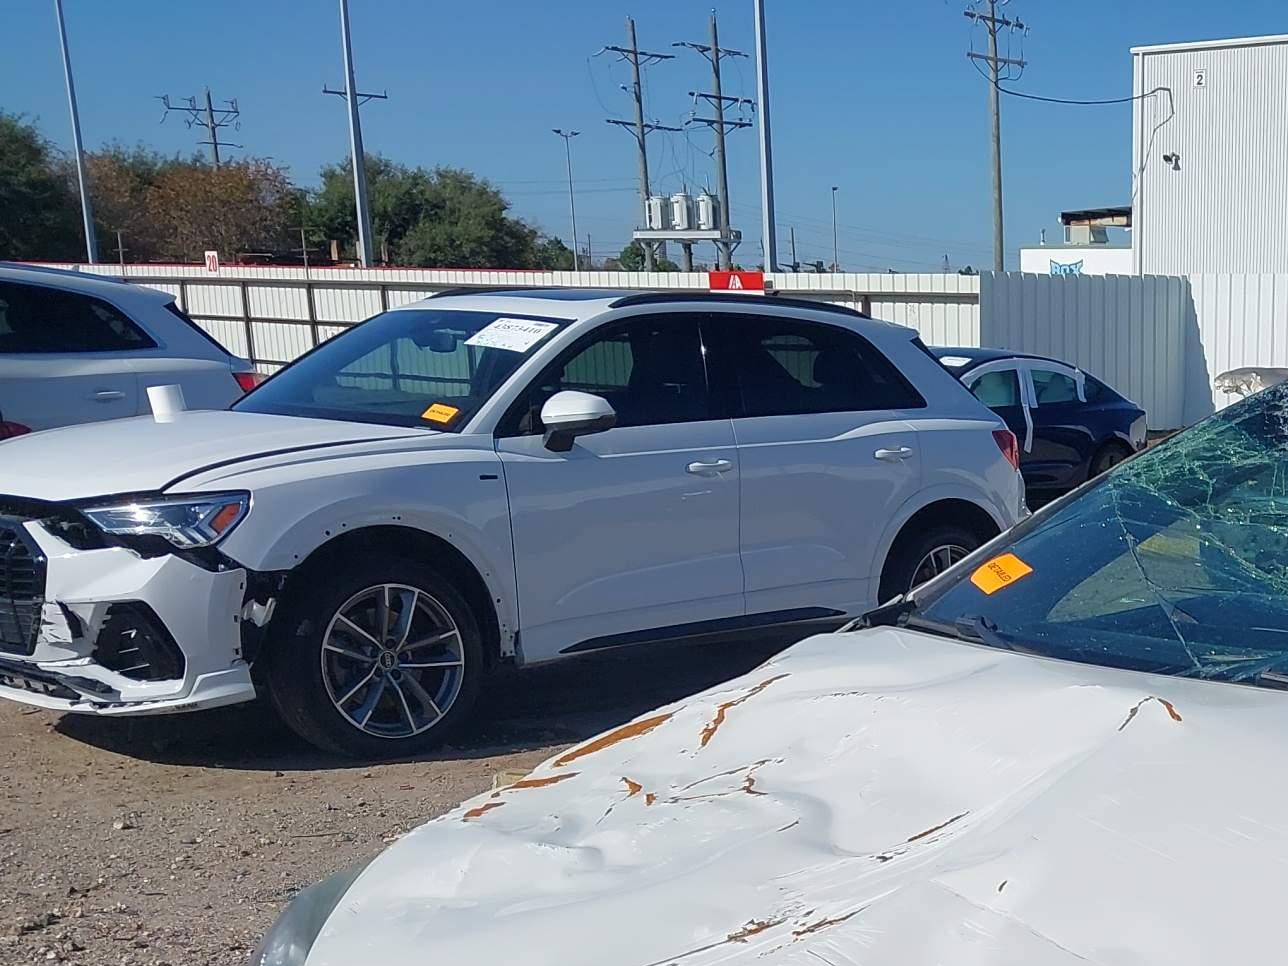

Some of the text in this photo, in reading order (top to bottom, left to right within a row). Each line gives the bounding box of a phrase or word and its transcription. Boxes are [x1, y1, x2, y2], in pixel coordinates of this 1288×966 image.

[1196, 74, 1204, 85] 2
[206, 254, 218, 272] 20
[987, 562, 1012, 582] DETAILED
